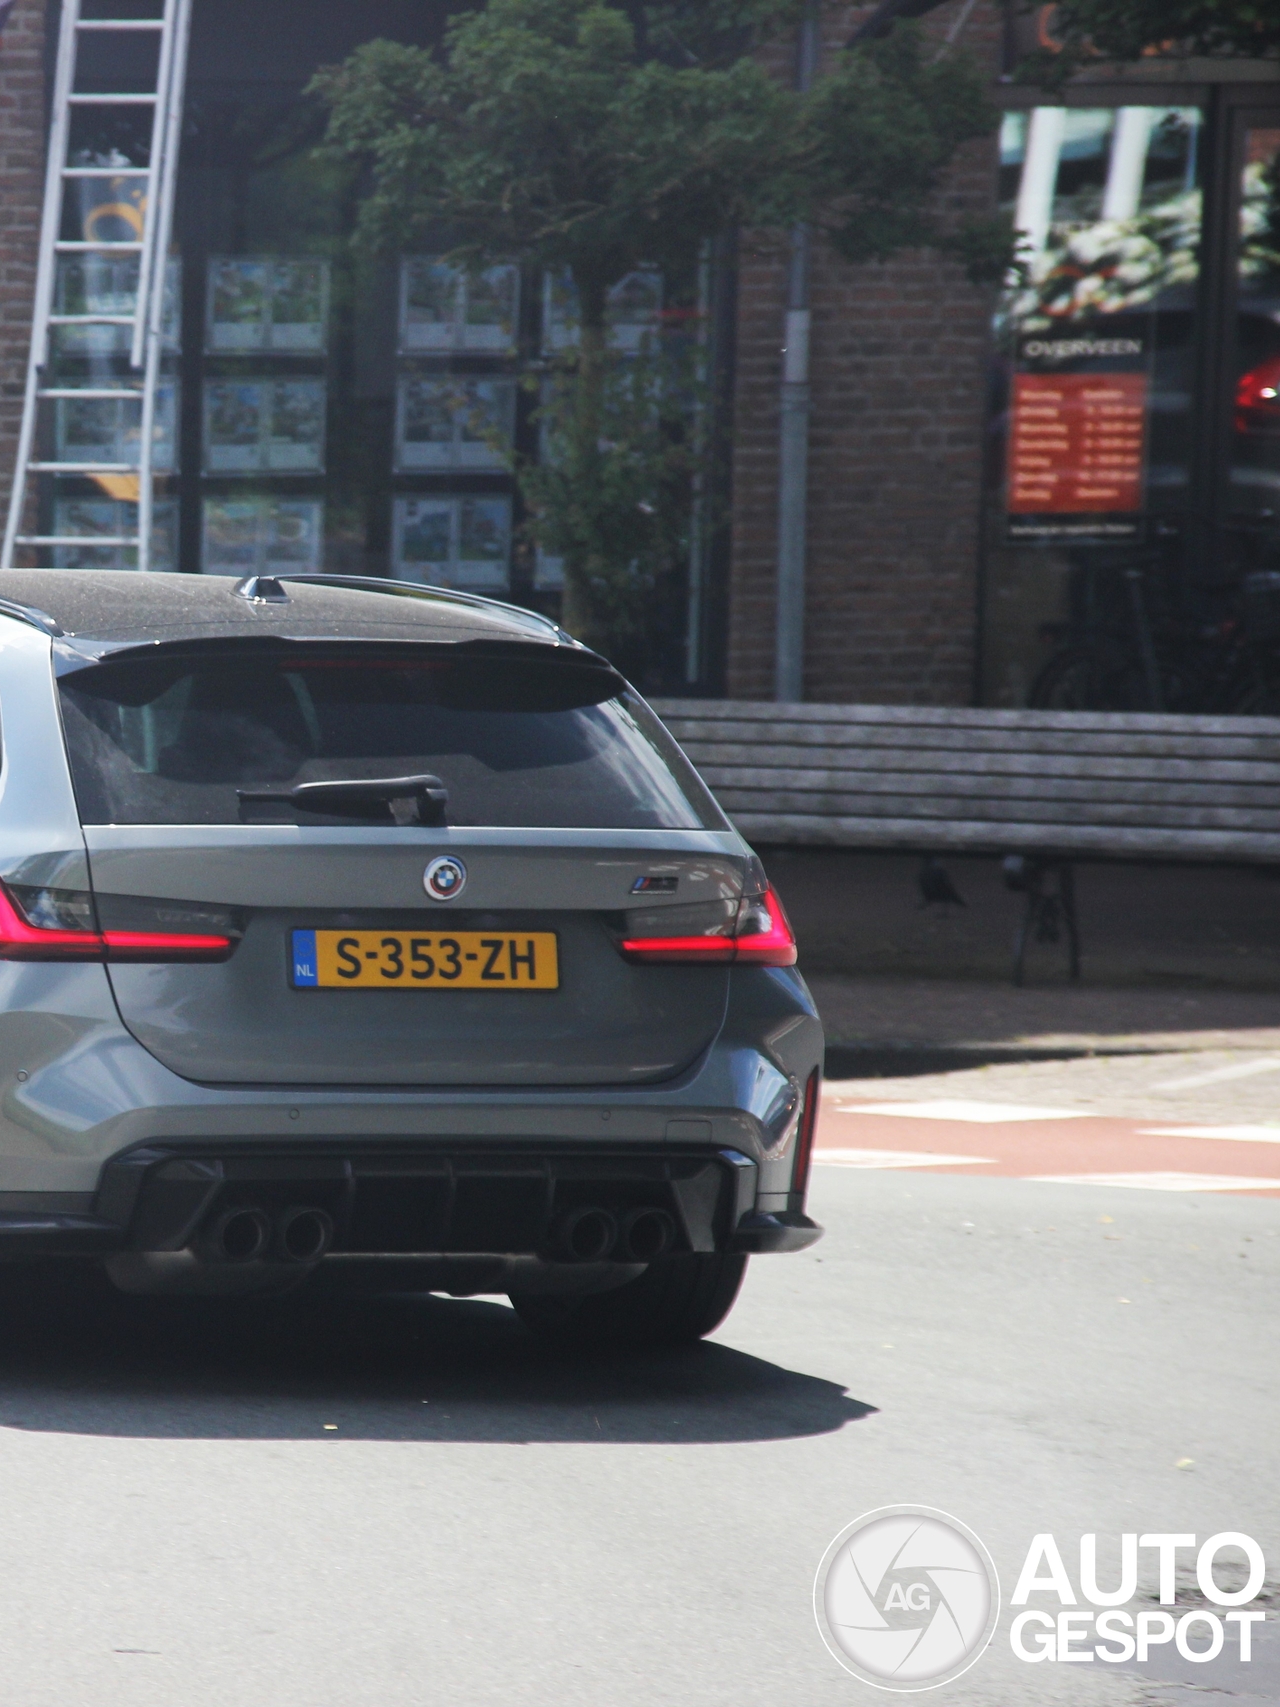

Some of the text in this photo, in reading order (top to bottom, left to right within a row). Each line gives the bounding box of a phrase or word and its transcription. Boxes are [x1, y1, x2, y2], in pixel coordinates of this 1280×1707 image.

[1025, 339, 1142, 357] OVERVEEN
[296, 937, 537, 980] NL S-353-ZH
